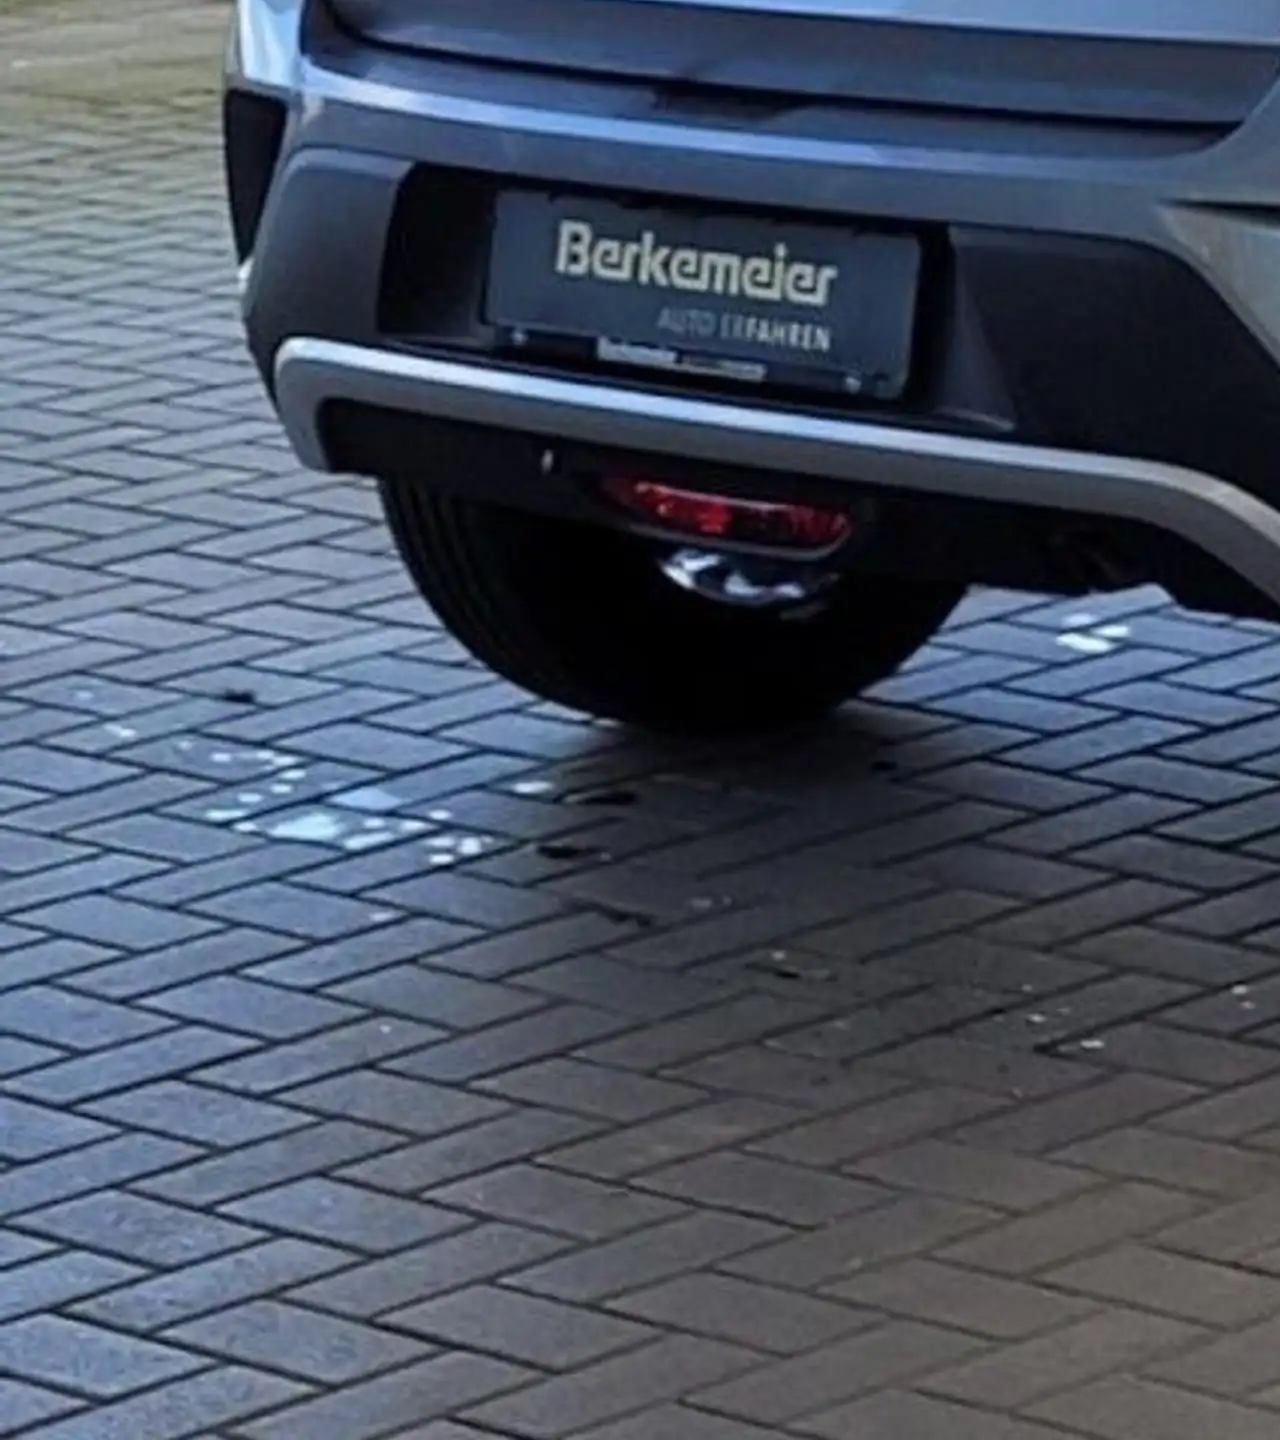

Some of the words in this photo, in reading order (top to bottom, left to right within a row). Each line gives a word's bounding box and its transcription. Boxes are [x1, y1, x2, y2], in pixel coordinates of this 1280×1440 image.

[555, 218, 839, 306] Berkemeier
[657, 306, 717, 339] AUTO
[719, 313, 832, 353] ERFAHREN
